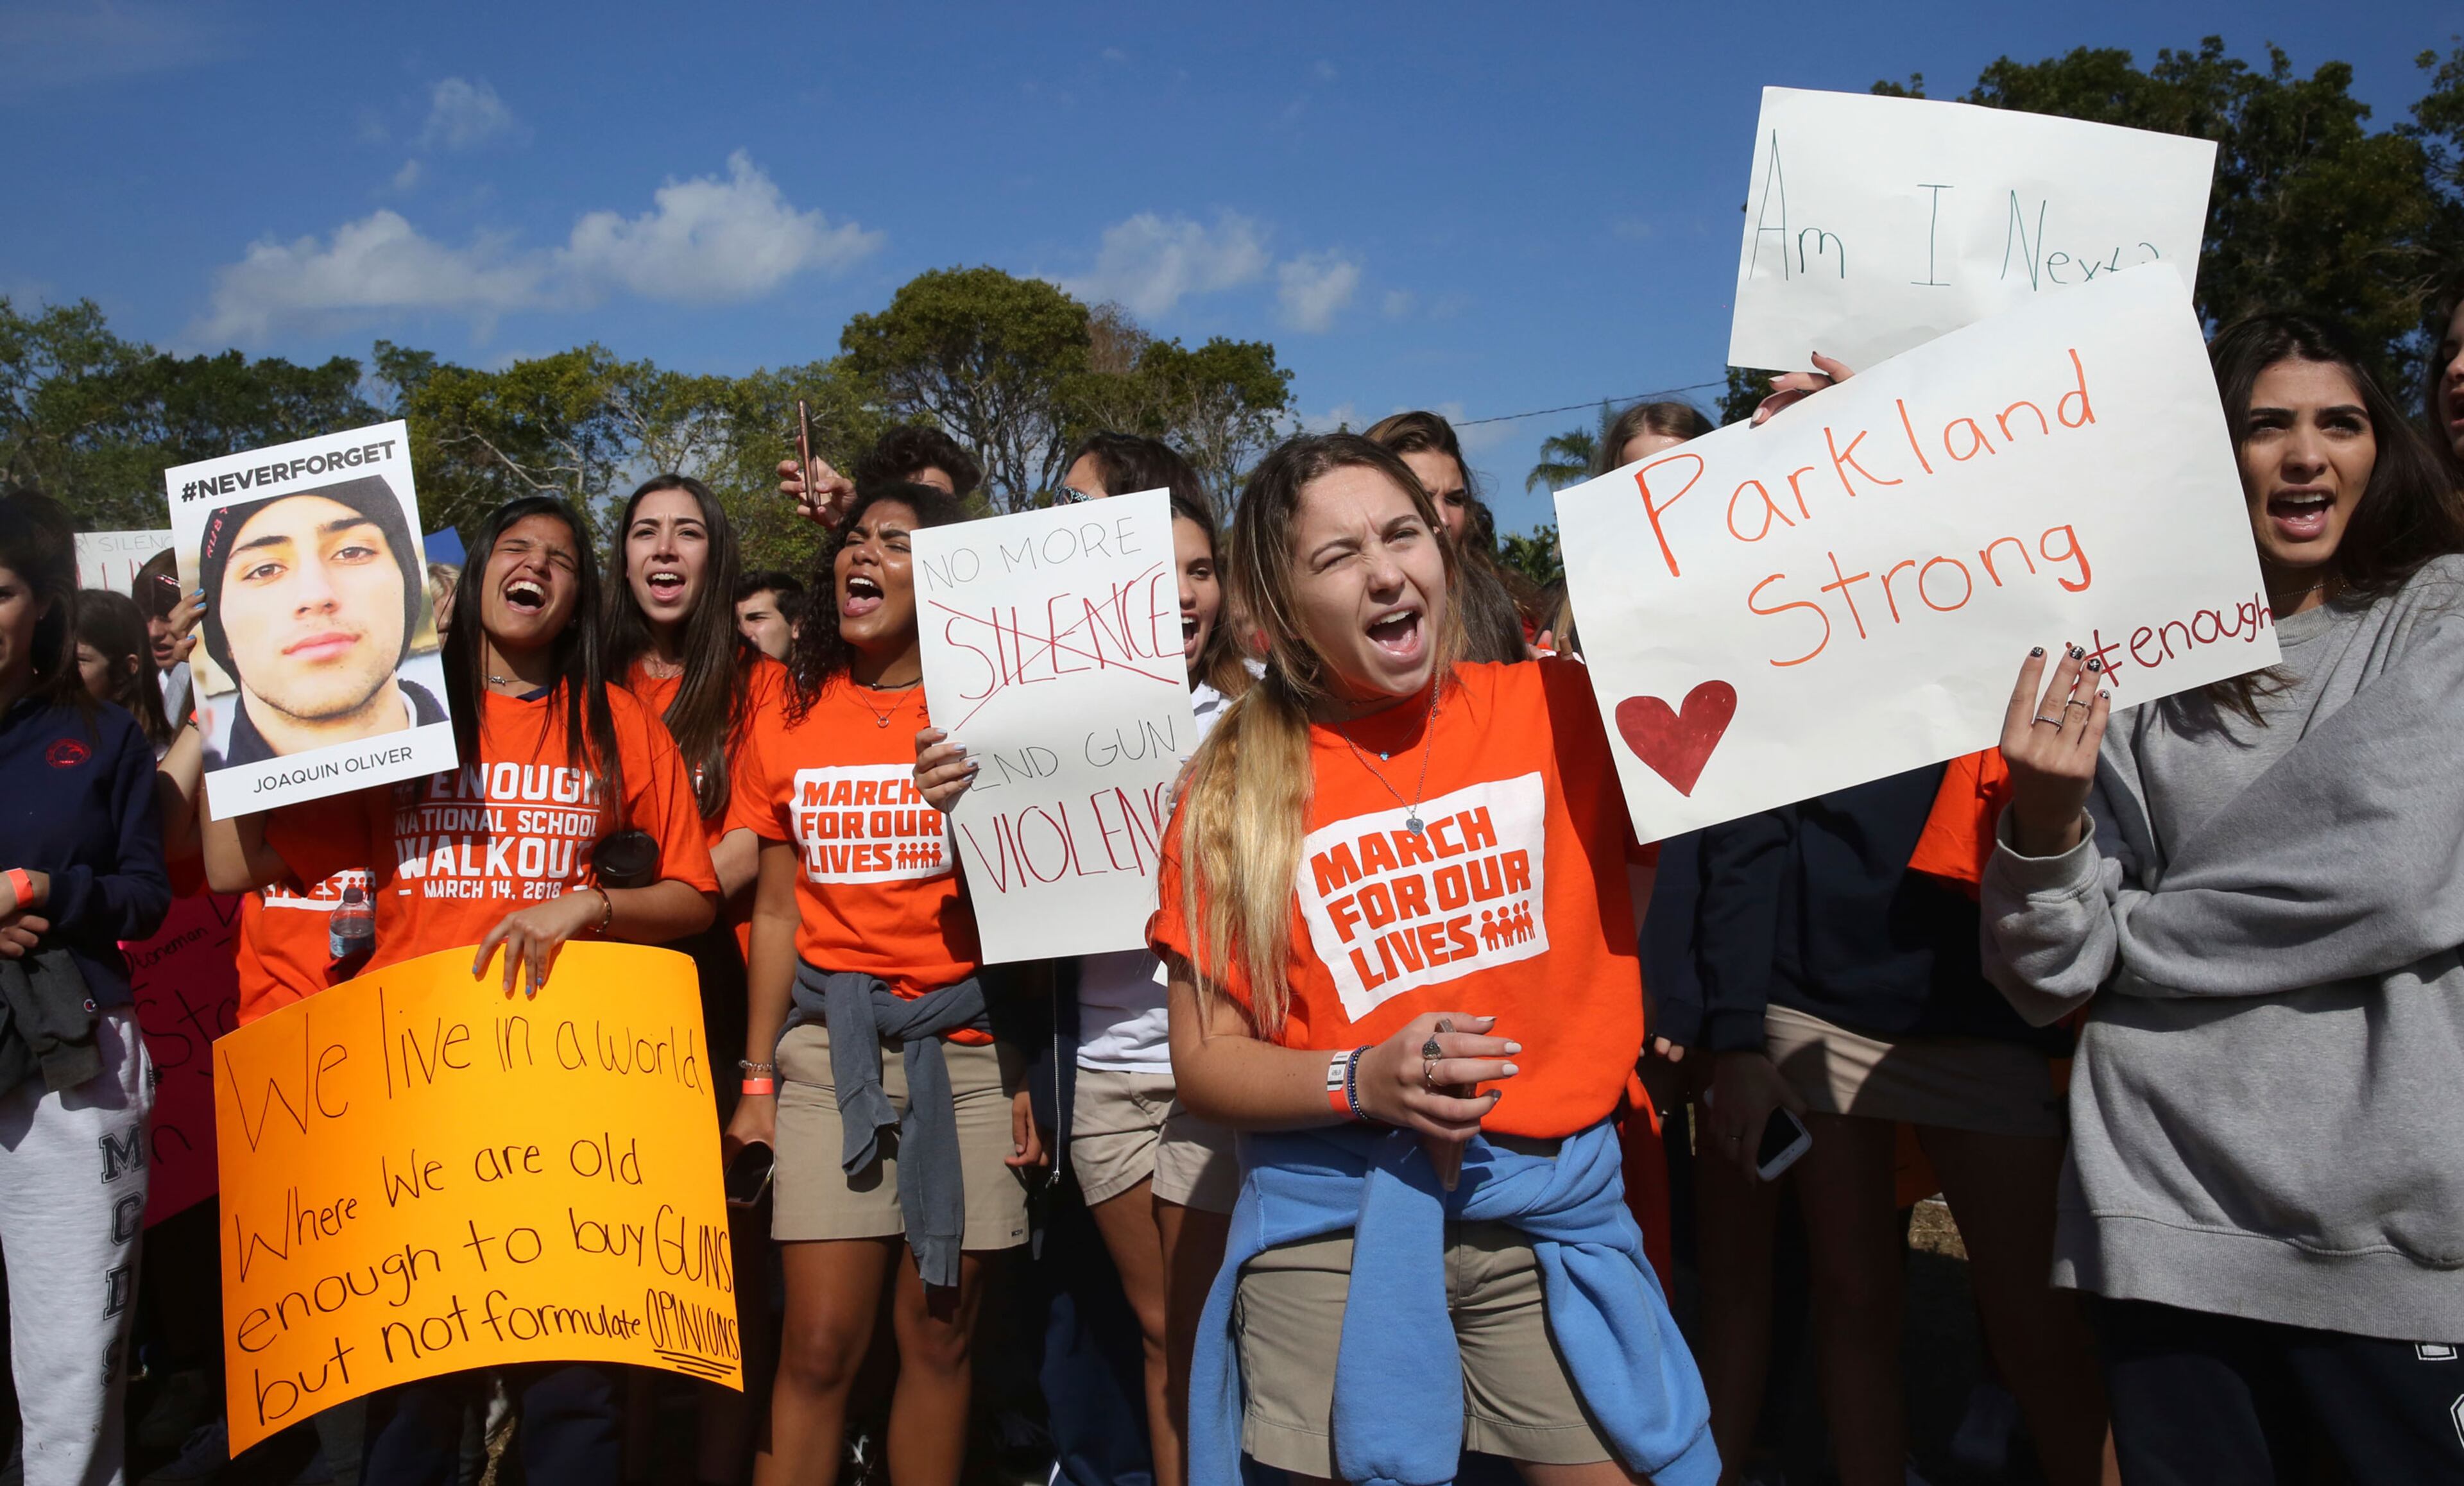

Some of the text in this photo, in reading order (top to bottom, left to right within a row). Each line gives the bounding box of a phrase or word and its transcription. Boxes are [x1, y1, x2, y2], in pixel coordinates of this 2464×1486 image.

[1749, 128, 1845, 282] Am
[1910, 184, 1955, 287] I
[181, 440, 396, 503] #NEVERFORGET
[1634, 348, 2097, 577] Parkland
[923, 517, 1142, 591] NO MORE
[1747, 524, 2092, 669] Strong
[945, 572, 1185, 701] SILENCE
[253, 746, 413, 794] JOAQUIN OLIVER
[1084, 714, 1177, 767] GUN
[395, 808, 508, 837] NATIONAL
[517, 810, 597, 837] SCHOOL
[800, 808, 943, 840] FOR OUR
[801, 778, 922, 808] MARCH
[394, 835, 594, 880] WALKOUT
[805, 842, 893, 874] LIVES
[1309, 805, 1498, 898] MARCH
[423, 879, 563, 901] MARCH 14, 2018
[1325, 848, 1532, 944] FOR OUR
[1348, 914, 1480, 993] LIVES
[223, 1012, 348, 1152] We
[379, 986, 471, 1099] live
[495, 1002, 533, 1072] in
[555, 1020, 587, 1071] a
[595, 1019, 705, 1096] world
[235, 1132, 643, 1283] Where We are old
[237, 1204, 733, 1353] enough to buy GUNS
[254, 1288, 740, 1427] but not formulate OPINIONS
